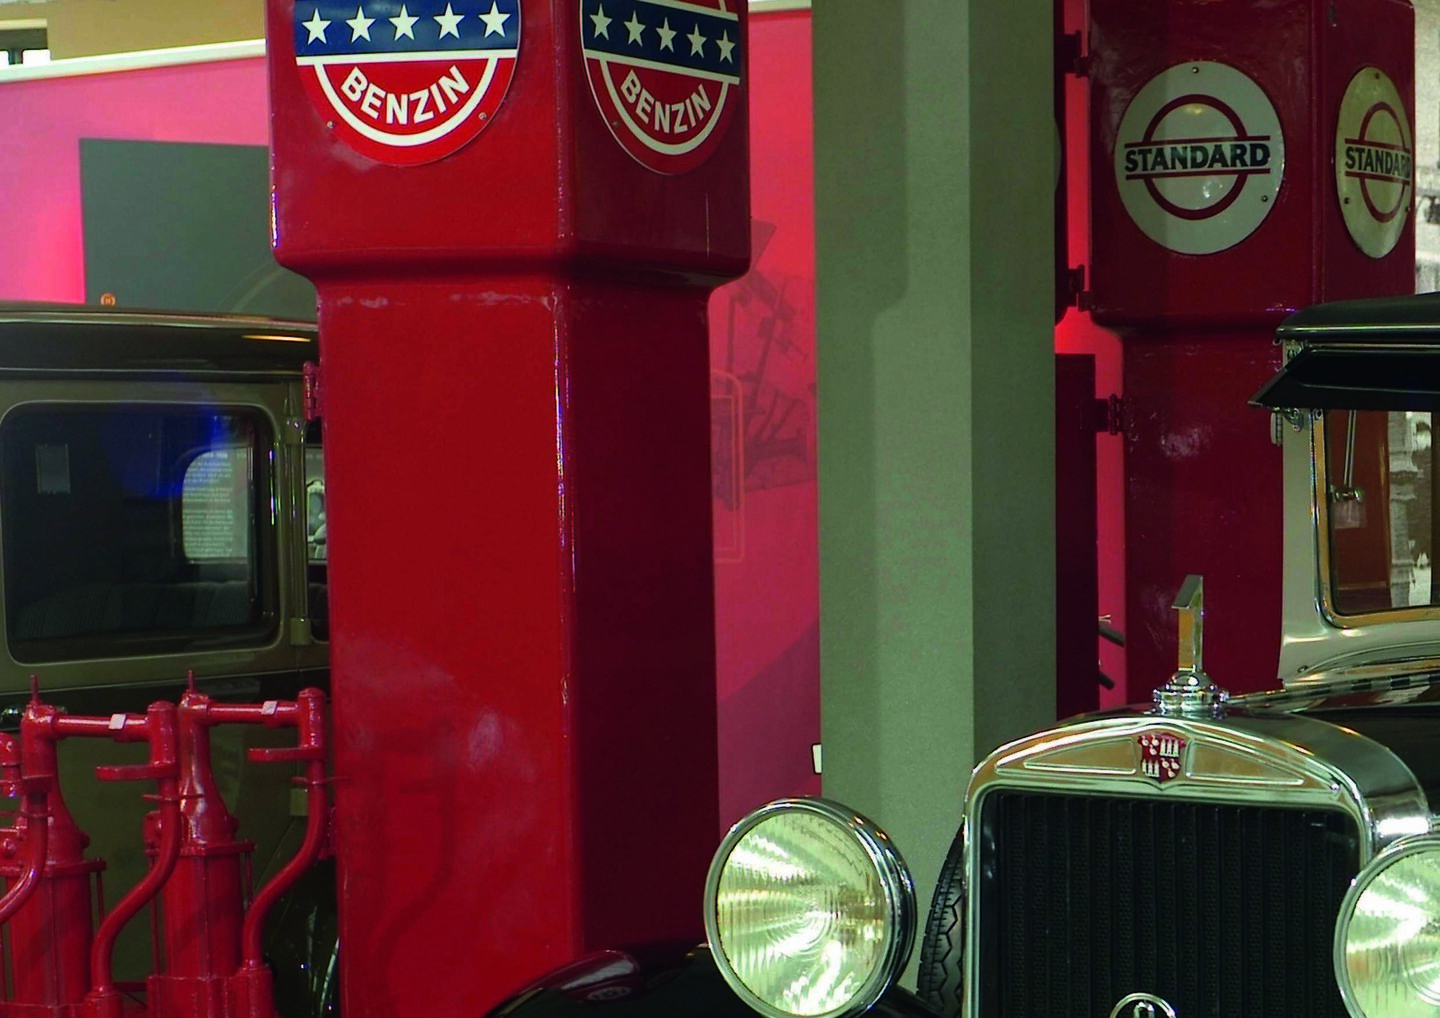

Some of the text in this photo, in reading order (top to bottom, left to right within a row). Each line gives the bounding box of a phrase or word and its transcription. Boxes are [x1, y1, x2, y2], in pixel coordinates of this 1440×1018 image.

[341, 65, 471, 125] BENZIN
[619, 69, 712, 134] BENZIN
[1125, 142, 1270, 172] STANDARD
[1345, 145, 1411, 179] STANDARD
